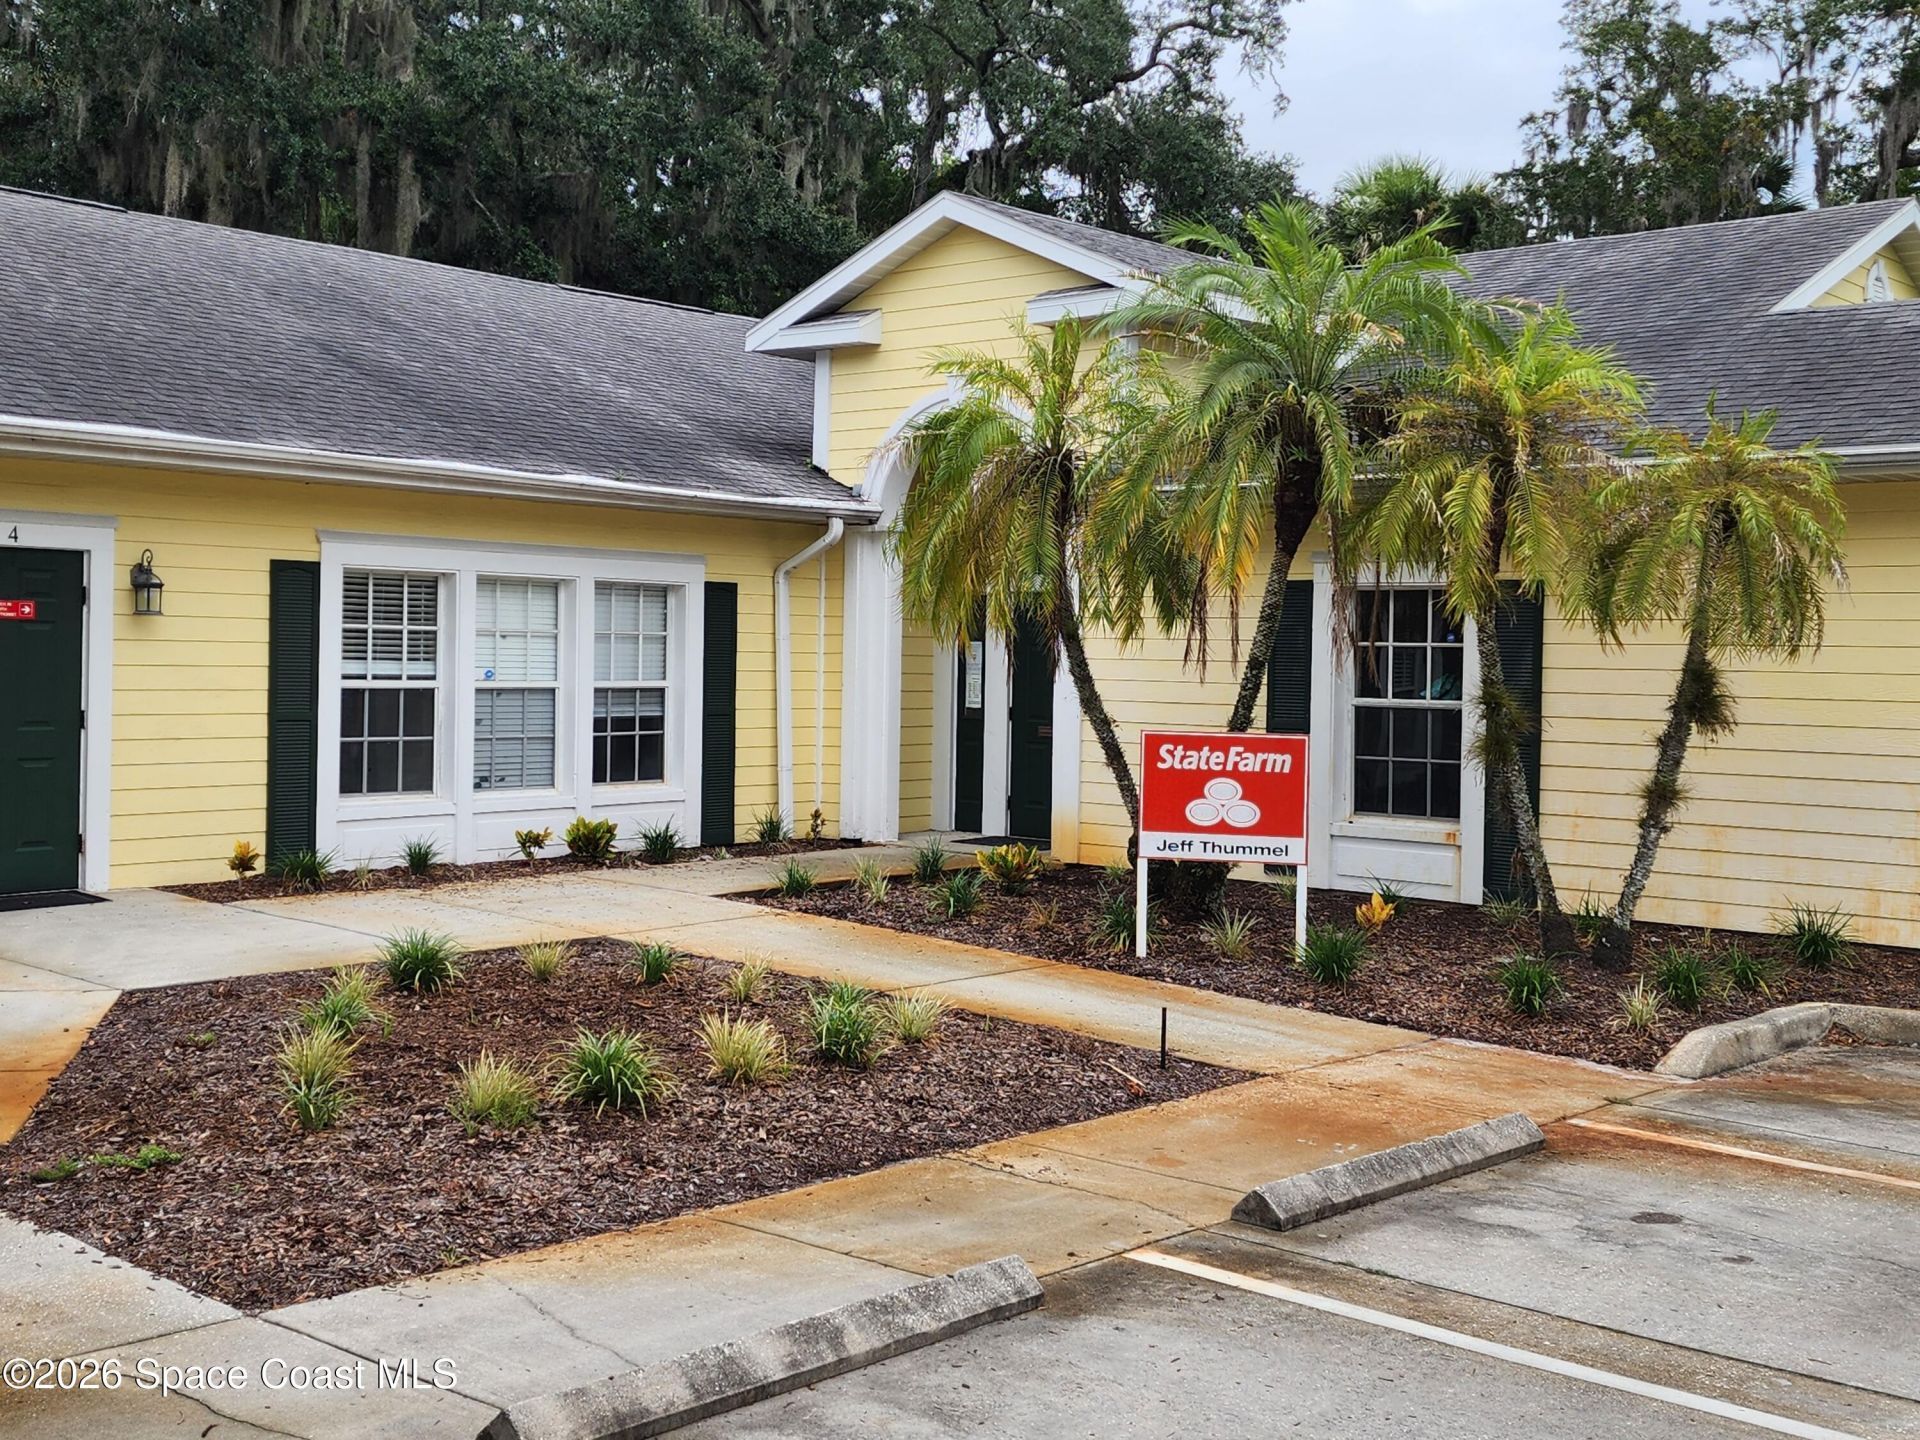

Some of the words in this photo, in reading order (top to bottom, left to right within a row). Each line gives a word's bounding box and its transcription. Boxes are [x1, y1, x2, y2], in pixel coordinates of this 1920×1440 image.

[8, 525, 19, 543] 4
[1156, 839, 1194, 853] Jeff
[1199, 840, 1289, 857] Thummel
